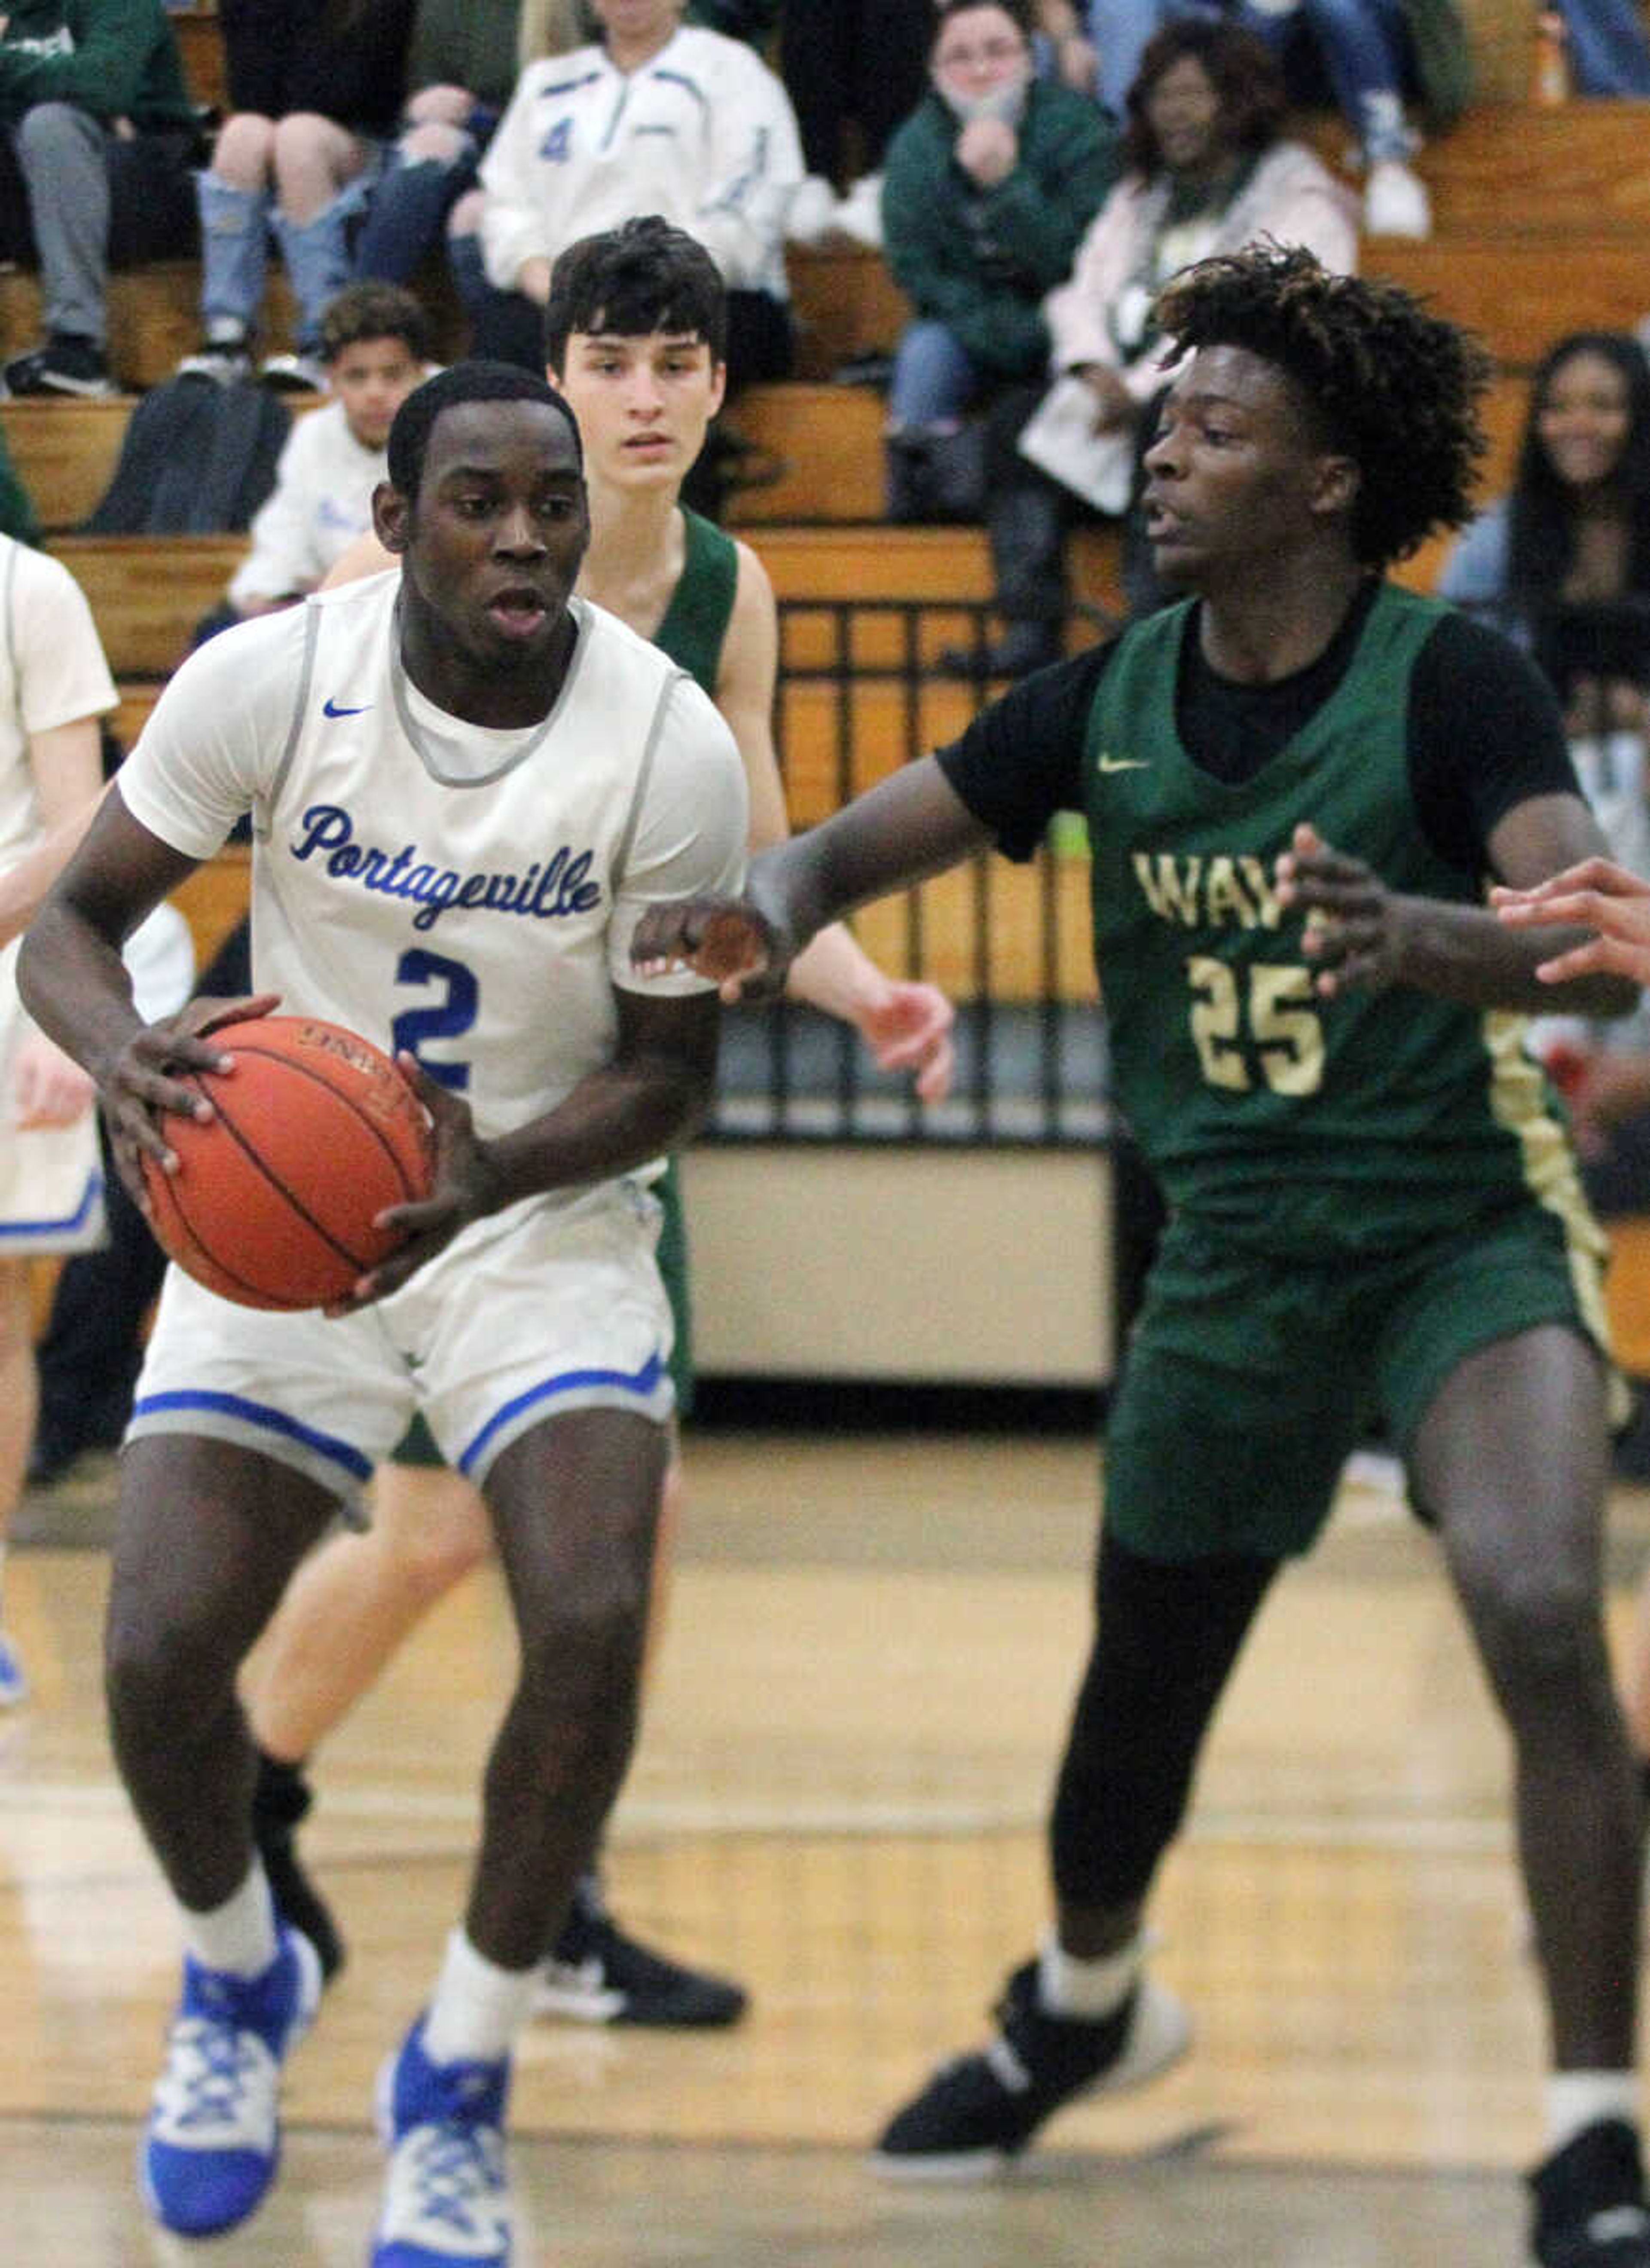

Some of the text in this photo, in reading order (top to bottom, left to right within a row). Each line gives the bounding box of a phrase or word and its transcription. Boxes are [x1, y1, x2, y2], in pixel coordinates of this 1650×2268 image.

[290, 805, 602, 931] Portageville
[1132, 853, 1326, 930] WAV
[391, 948, 479, 1091] 2
[1187, 955, 1326, 1097] 25
